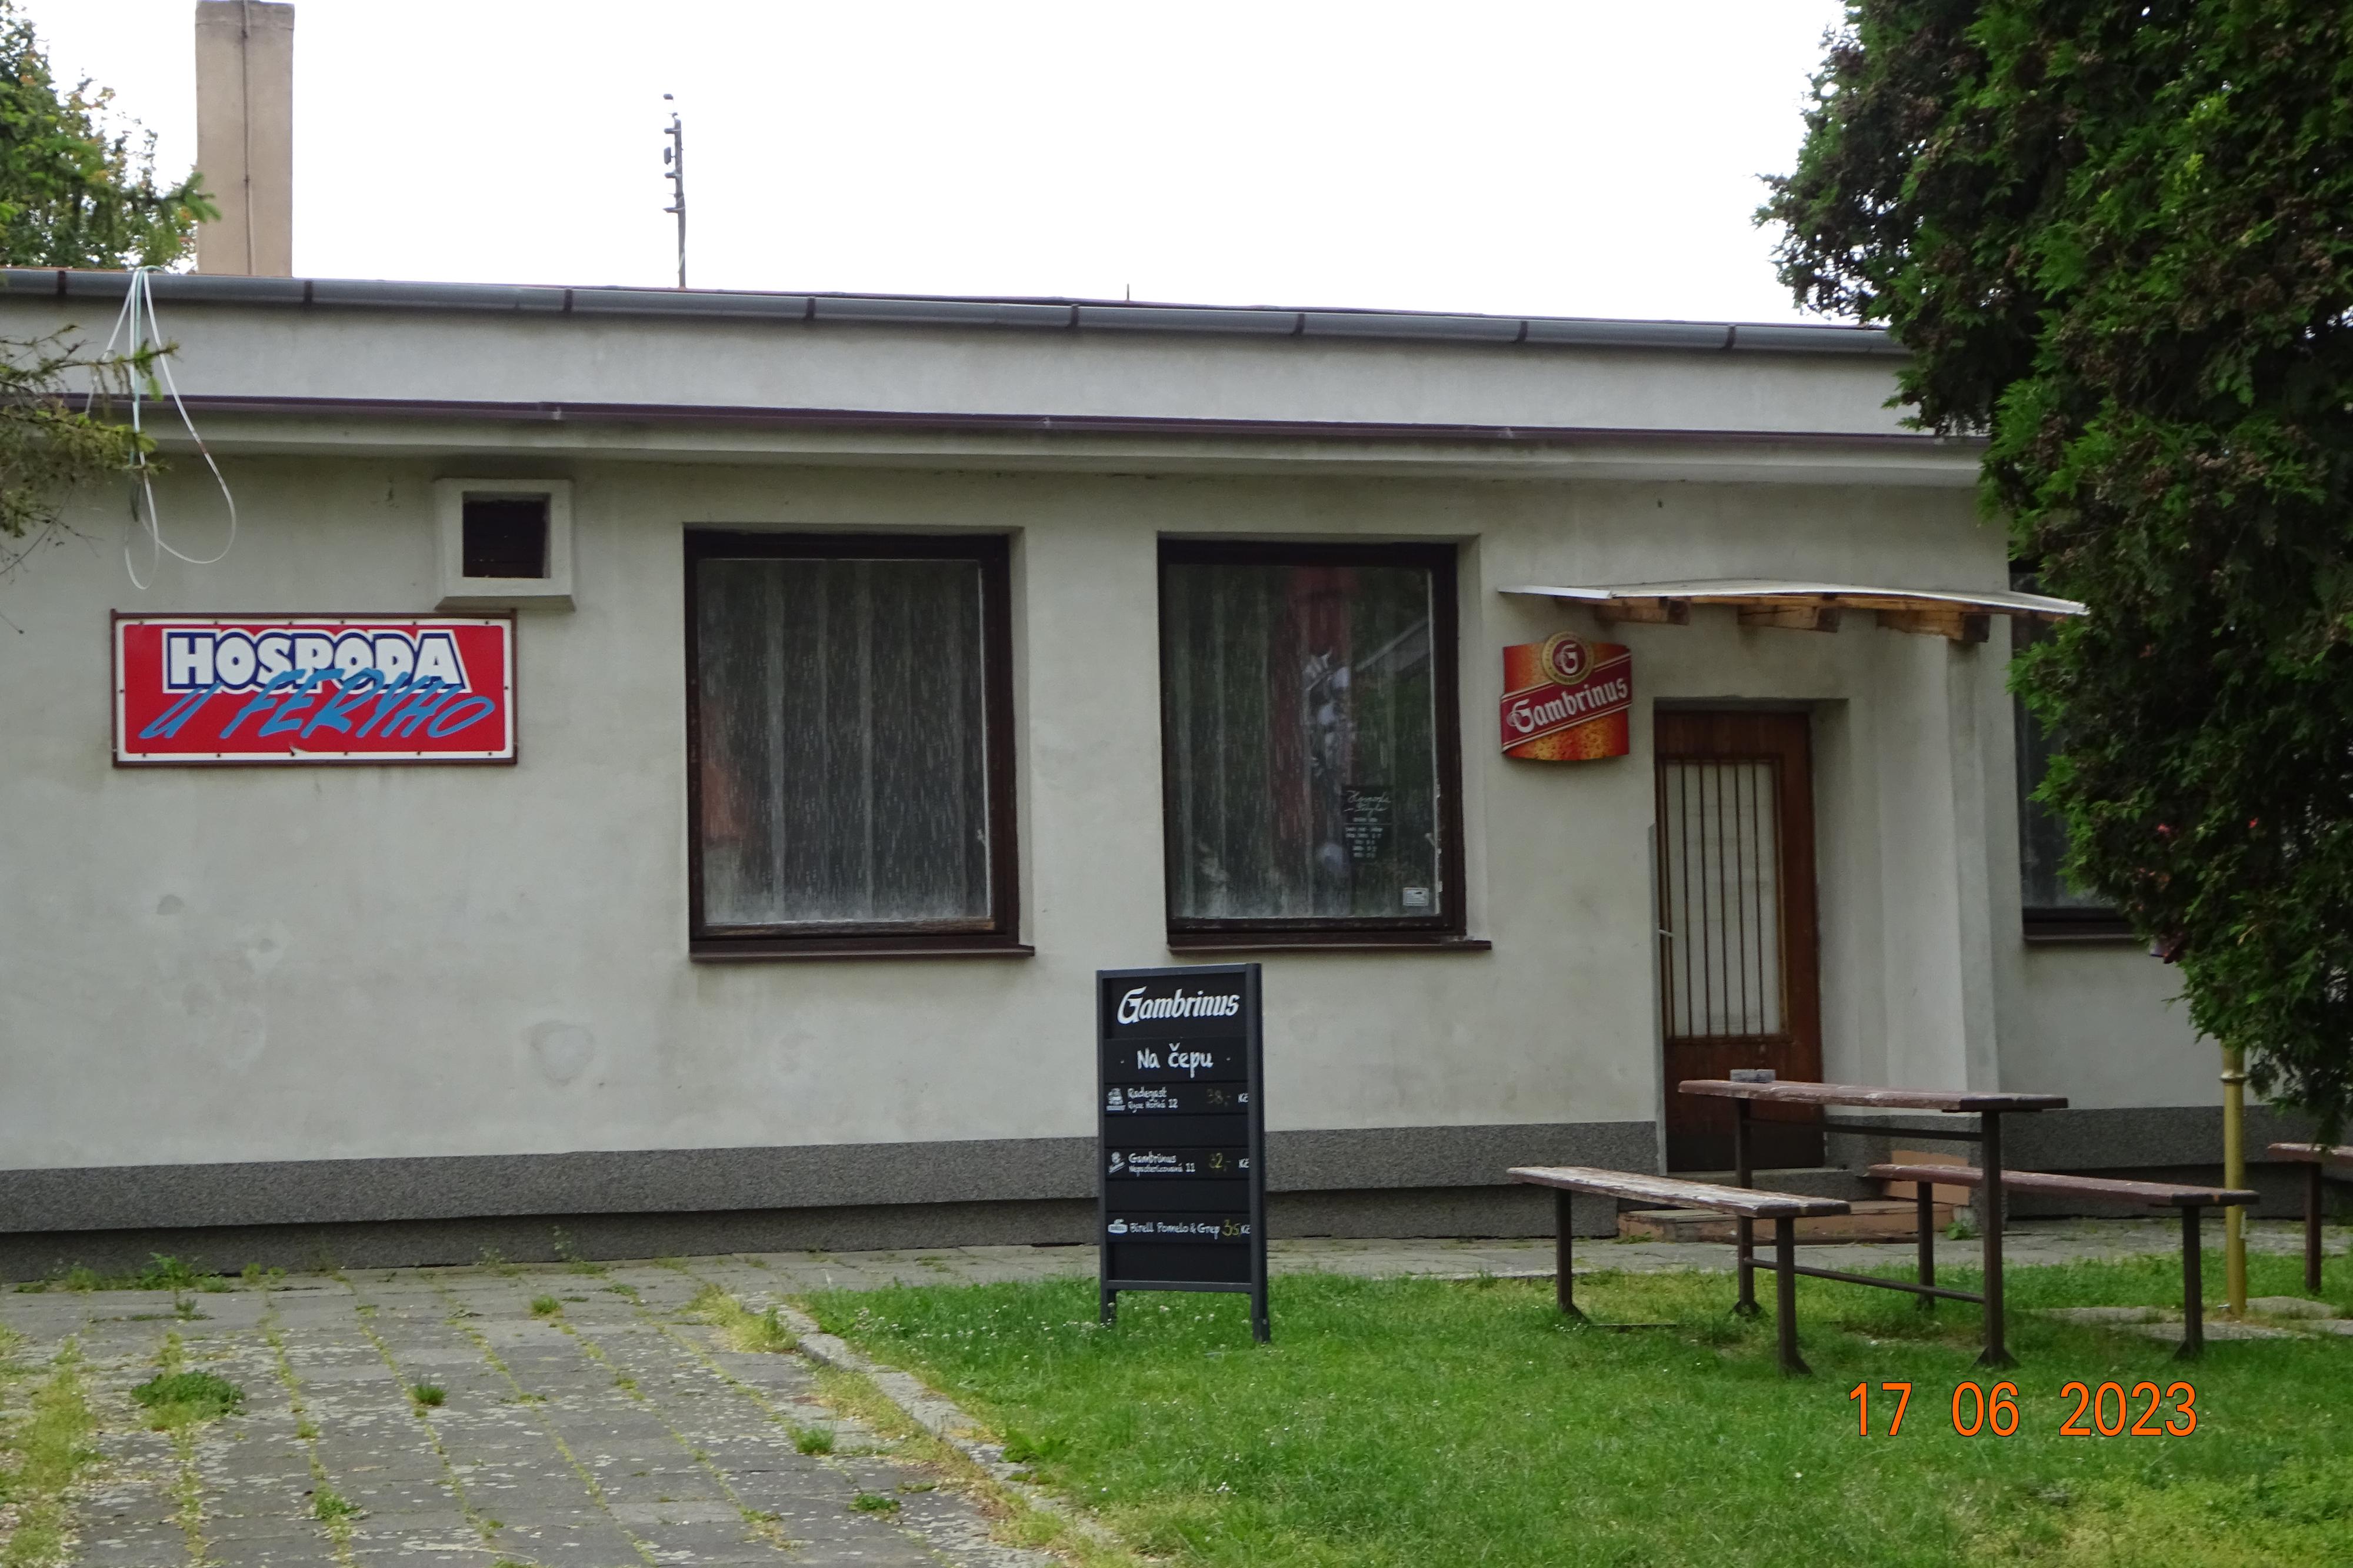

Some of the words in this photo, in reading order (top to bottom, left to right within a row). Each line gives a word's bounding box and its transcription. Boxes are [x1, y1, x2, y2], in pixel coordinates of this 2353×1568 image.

[164, 631, 468, 690] HOSPODA
[219, 667, 495, 739] FERYHO
[1507, 678, 1629, 733] Gambrinus
[1117, 986, 1240, 1025] Gambrinus
[1136, 1047, 1161, 1070] Na
[1167, 1042, 1214, 1079] čepu
[1168, 1098, 1178, 1109] 12
[1238, 1093, 1249, 1103] Kč
[1128, 1150, 1176, 1163] Gambrinus
[1185, 1162, 1196, 1173] 11
[1238, 1158, 1249, 1169] Kč
[1129, 1222, 1155, 1233] Birell
[1156, 1222, 1189, 1233] Pomelo
[1189, 1223, 1197, 1234] &
[1240, 1224, 1251, 1235] Kč
